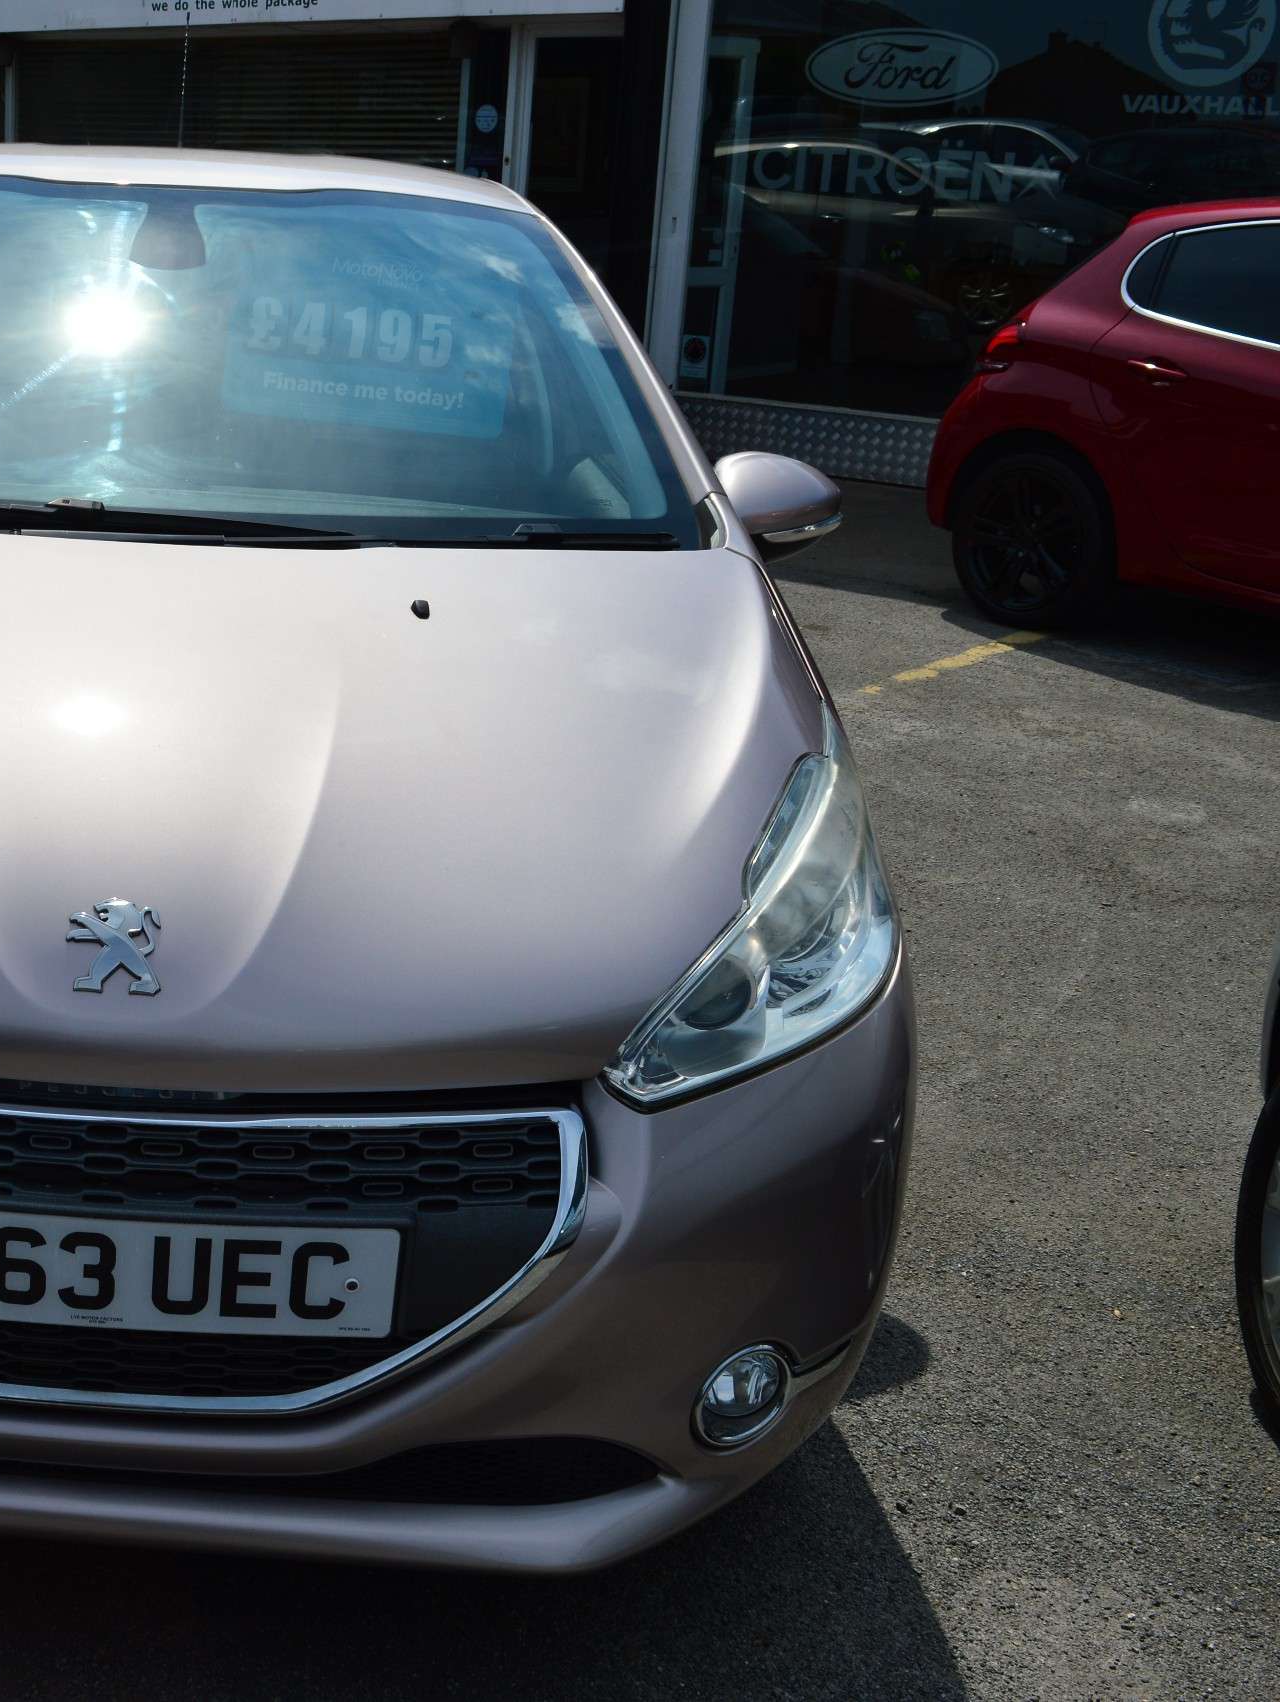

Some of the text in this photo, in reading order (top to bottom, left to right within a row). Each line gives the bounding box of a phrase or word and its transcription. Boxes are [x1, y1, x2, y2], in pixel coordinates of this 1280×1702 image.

[152, 3, 168, 11] we
[174, 0, 188, 11] do
[195, 0, 215, 9] the
[844, 41, 956, 89] Ford
[1122, 94, 1280, 116] VAUXHALL
[753, 139, 1018, 201] CITROËN
[248, 296, 453, 369] £4195
[263, 371, 464, 410] Finance me today!
[152, 1235, 350, 1320] UEC
